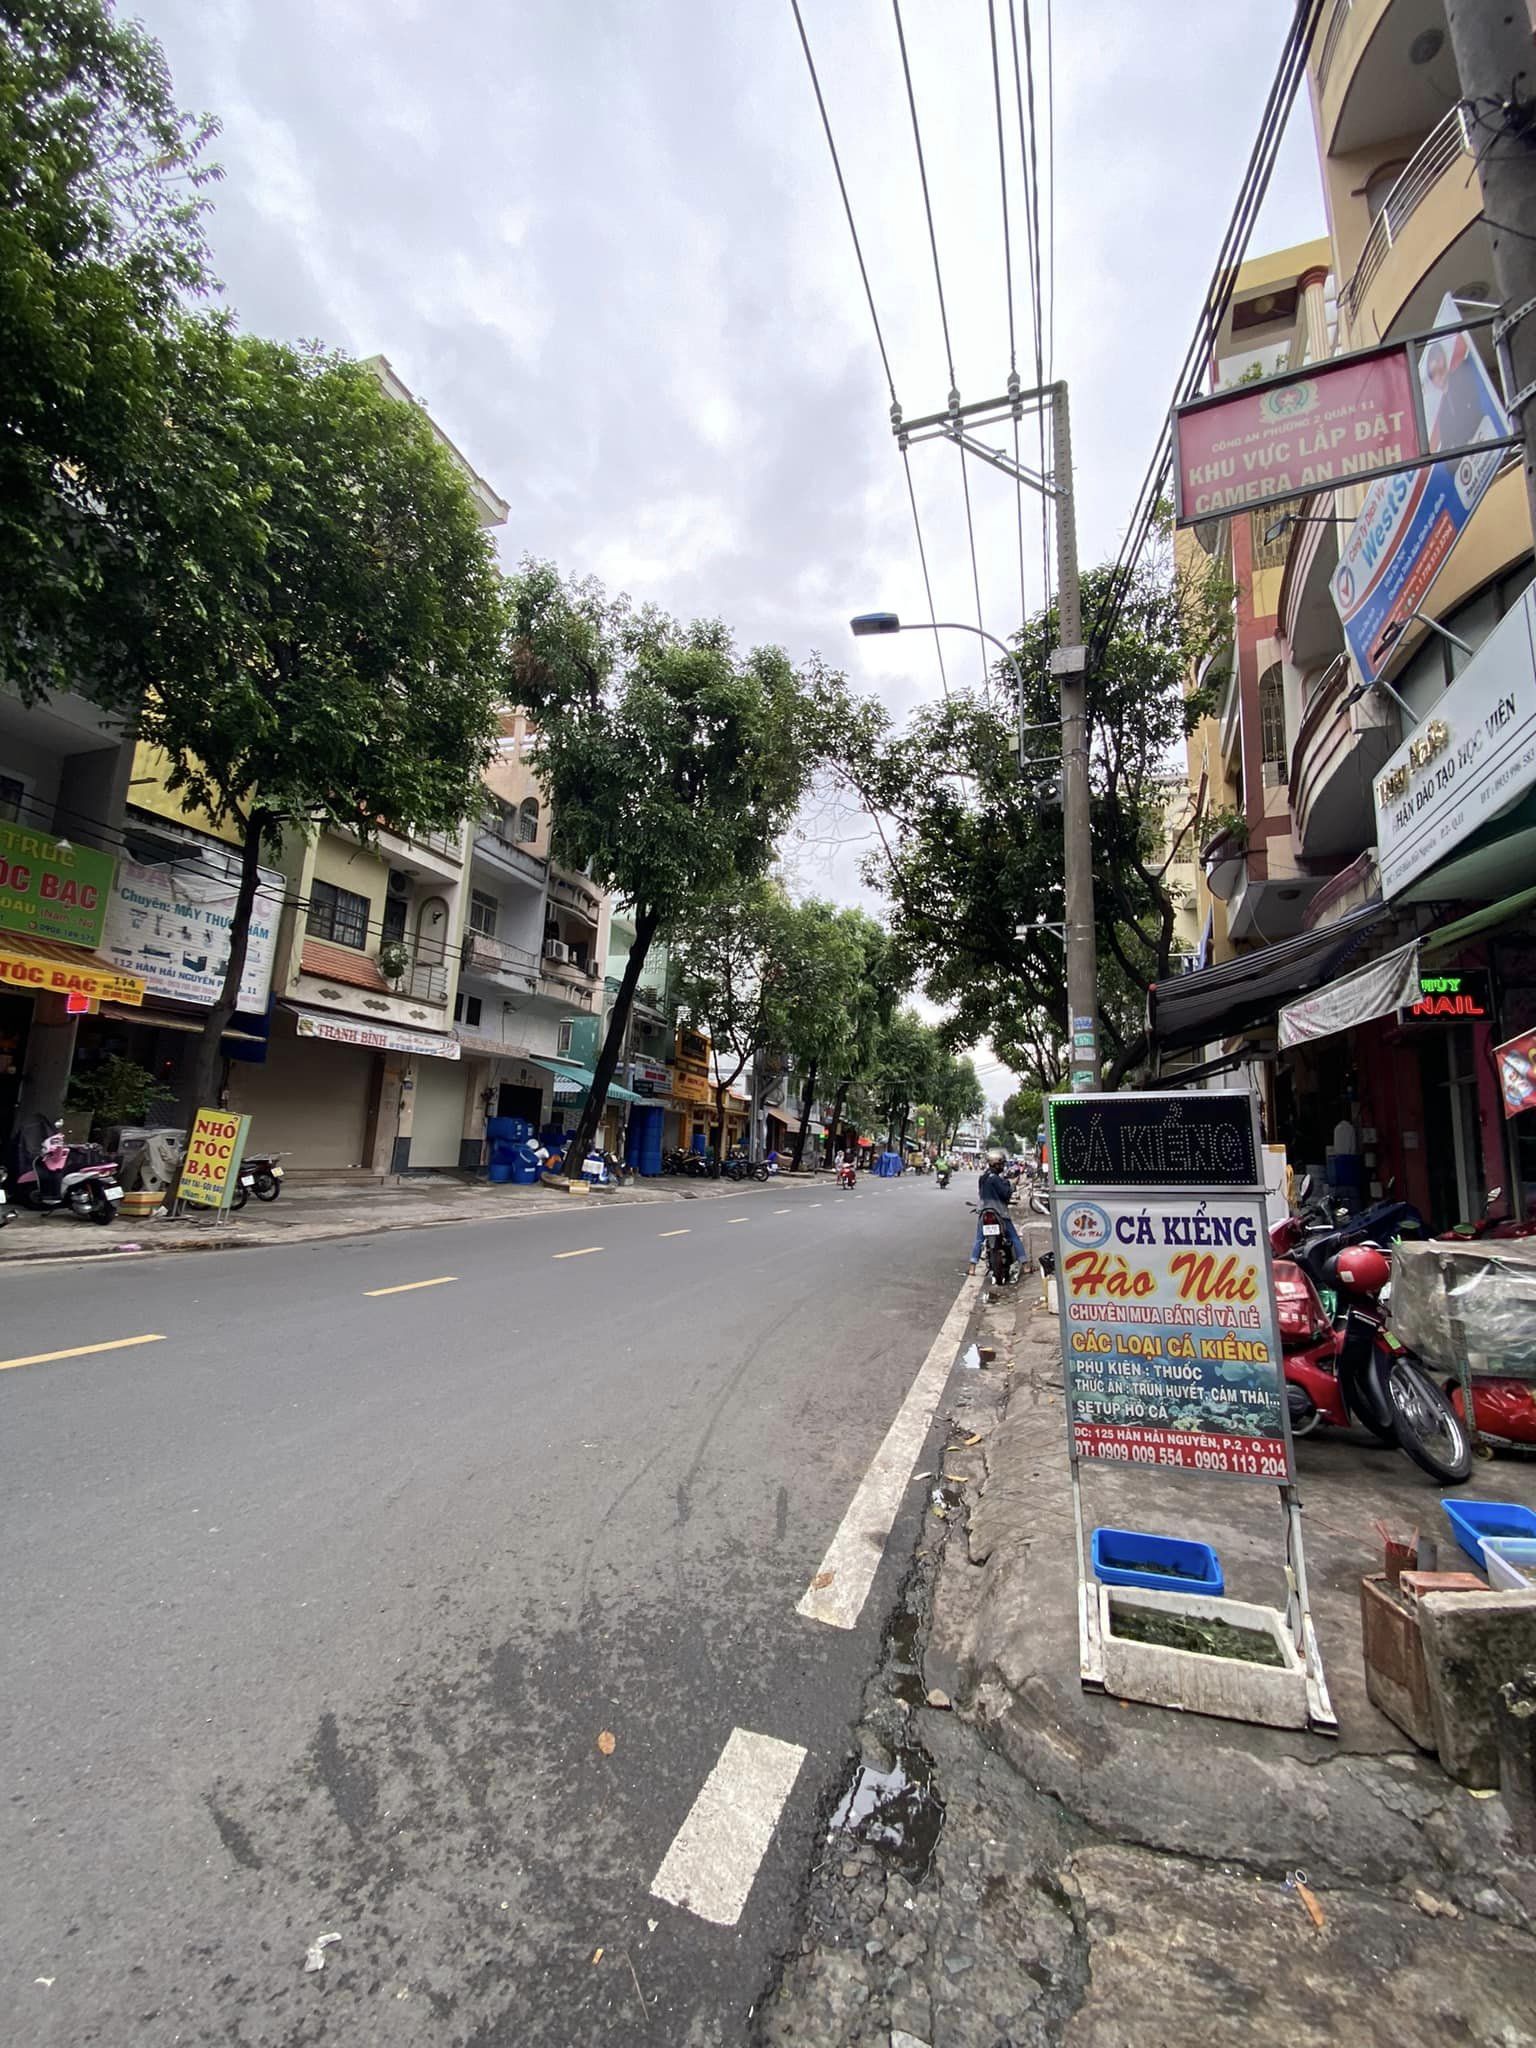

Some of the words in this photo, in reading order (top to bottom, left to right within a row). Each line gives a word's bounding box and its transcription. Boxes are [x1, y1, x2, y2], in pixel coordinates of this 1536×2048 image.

[1244, 431, 1261, 445] AN
[1313, 414, 1322, 425] 2
[1361, 400, 1375, 411] 11
[1188, 461, 1236, 487] KHU
[1243, 442, 1291, 471] VỰC
[1354, 410, 1406, 442] ĐẶT
[1195, 473, 1293, 514] CAMERA
[1301, 460, 1334, 488] AN
[1341, 442, 1403, 476] NINH
[1437, 757, 1456, 790] TẠO
[1485, 692, 1517, 740] VIÊN
[39, 871, 98, 911] BẠC
[121, 887, 171, 912] Chuyên:
[174, 903, 202, 921] MÁY
[0, 959, 45, 984] TÓC
[113, 957, 133, 970] 112
[113, 975, 137, 989] 114
[1413, 995, 1485, 1016] NAIL
[317, 1023, 358, 1043] THANH
[360, 1029, 389, 1048] BÌNH
[195, 1117, 240, 1139] NHỔ
[1061, 1113, 1114, 1172] CÁ
[1120, 1102, 1245, 1172] KIỂNG
[193, 1139, 231, 1159] TÓC
[186, 1160, 227, 1180] BẠC
[1115, 1208, 1157, 1245] CÁ
[1161, 1200, 1257, 1247] KIỂNG
[1064, 1250, 1156, 1298] Hào
[1170, 1251, 1258, 1302] Nhi
[1069, 1302, 1127, 1321] CHUYÊN
[1130, 1305, 1160, 1323] MUA
[1163, 1303, 1195, 1325] BÁN
[1197, 1303, 1213, 1327] SỈ
[1215, 1306, 1238, 1328] VÀ
[1239, 1304, 1260, 1328] LẺ
[1071, 1328, 1113, 1353] CÁC
[1116, 1335, 1163, 1361] LOẠI
[1167, 1332, 1197, 1358] CÁ
[1200, 1330, 1269, 1363] KIỂNG
[1076, 1359, 1104, 1378] PHỤ
[1108, 1361, 1142, 1380] KIỆN
[1153, 1361, 1203, 1380] THUỐC
[1077, 1400, 1124, 1416] SETUP
[1125, 1400, 1145, 1417] HỒ
[1148, 1402, 1169, 1420] CÁ
[1095, 1429, 1114, 1440] 125
[1116, 1428, 1141, 1442] HÀN
[1143, 1430, 1165, 1444] HẢI
[1167, 1432, 1222, 1451] NGUYÊN,
[1223, 1439, 1243, 1451] P.2
[1251, 1441, 1265, 1453] Q.
[1268, 1442, 1283, 1454] 11
[1097, 1441, 1130, 1460] 0909
[1131, 1445, 1157, 1464] 009
[1159, 1448, 1184, 1467] 554
[1194, 1450, 1229, 1471] 0903
[1231, 1453, 1258, 1474] 113
[1261, 1456, 1287, 1477] 204
